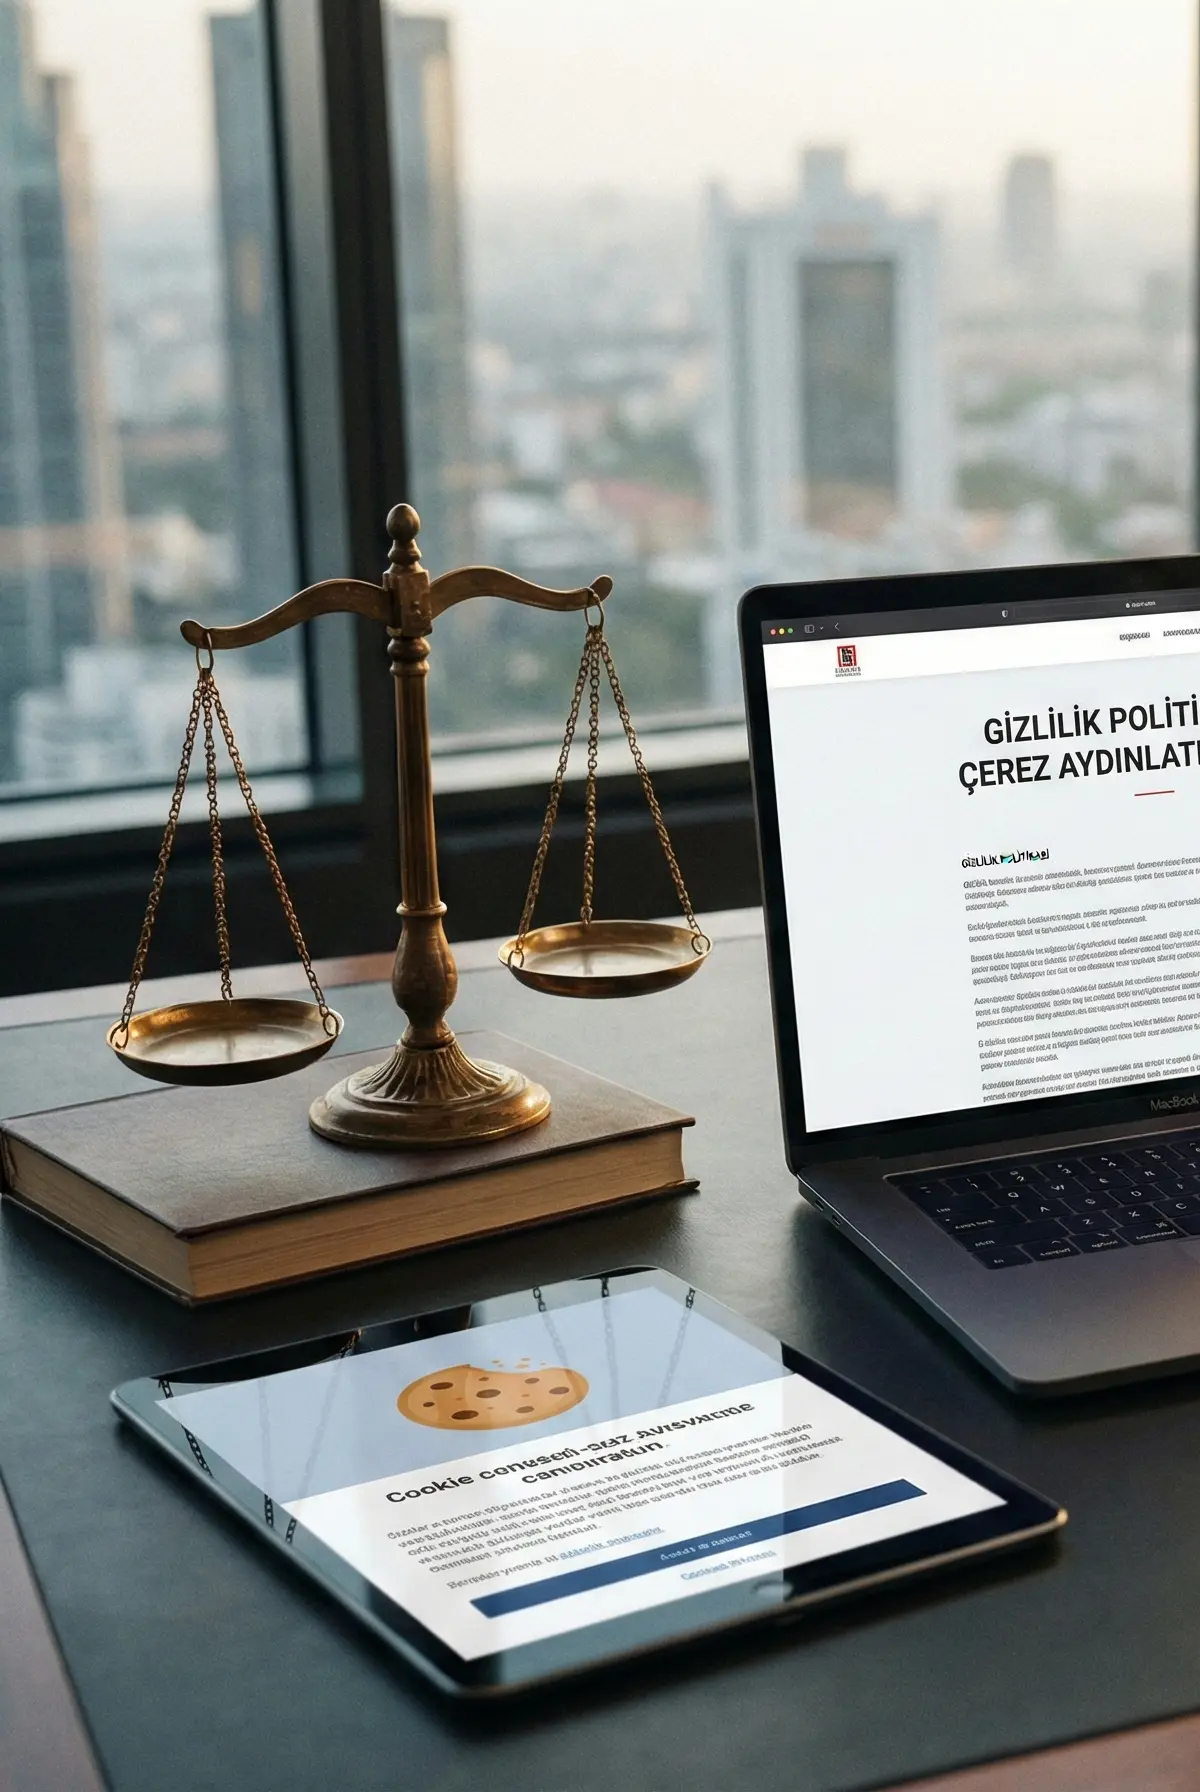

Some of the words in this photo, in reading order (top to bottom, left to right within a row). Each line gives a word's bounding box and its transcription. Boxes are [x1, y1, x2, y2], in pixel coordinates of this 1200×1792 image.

[983, 704, 1104, 745] GİZLİLİK
[958, 754, 1052, 796] ÇEREZ
[1150, 1094, 1199, 1112] MacBook
[385, 1475, 475, 1503] Cookie
